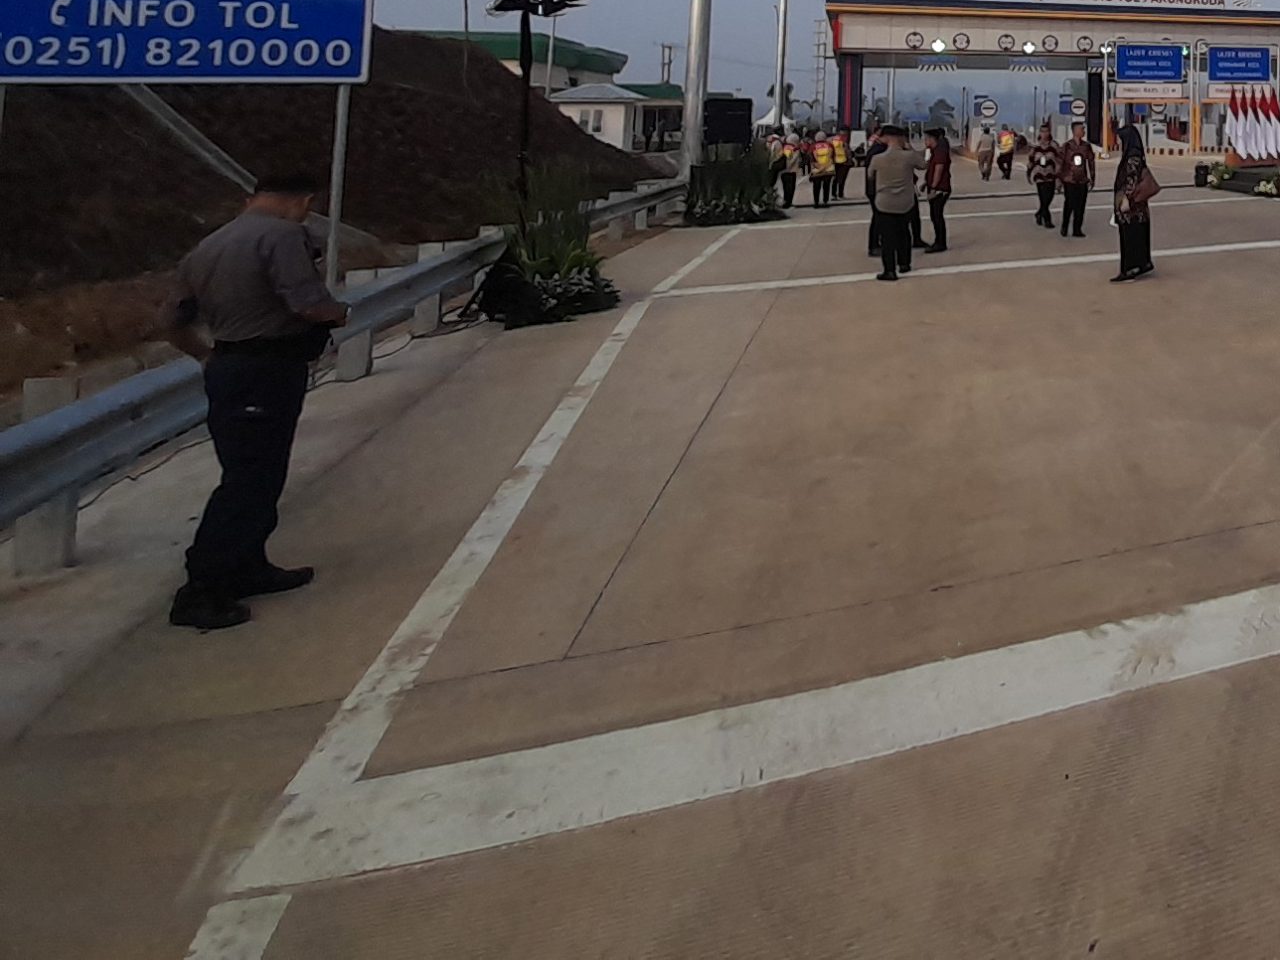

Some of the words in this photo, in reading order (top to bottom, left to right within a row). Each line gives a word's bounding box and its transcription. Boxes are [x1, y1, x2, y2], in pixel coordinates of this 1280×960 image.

[218, 1, 300, 30] TOL
[0, 31, 127, 70] 0251)
[145, 37, 352, 68] 8210000
